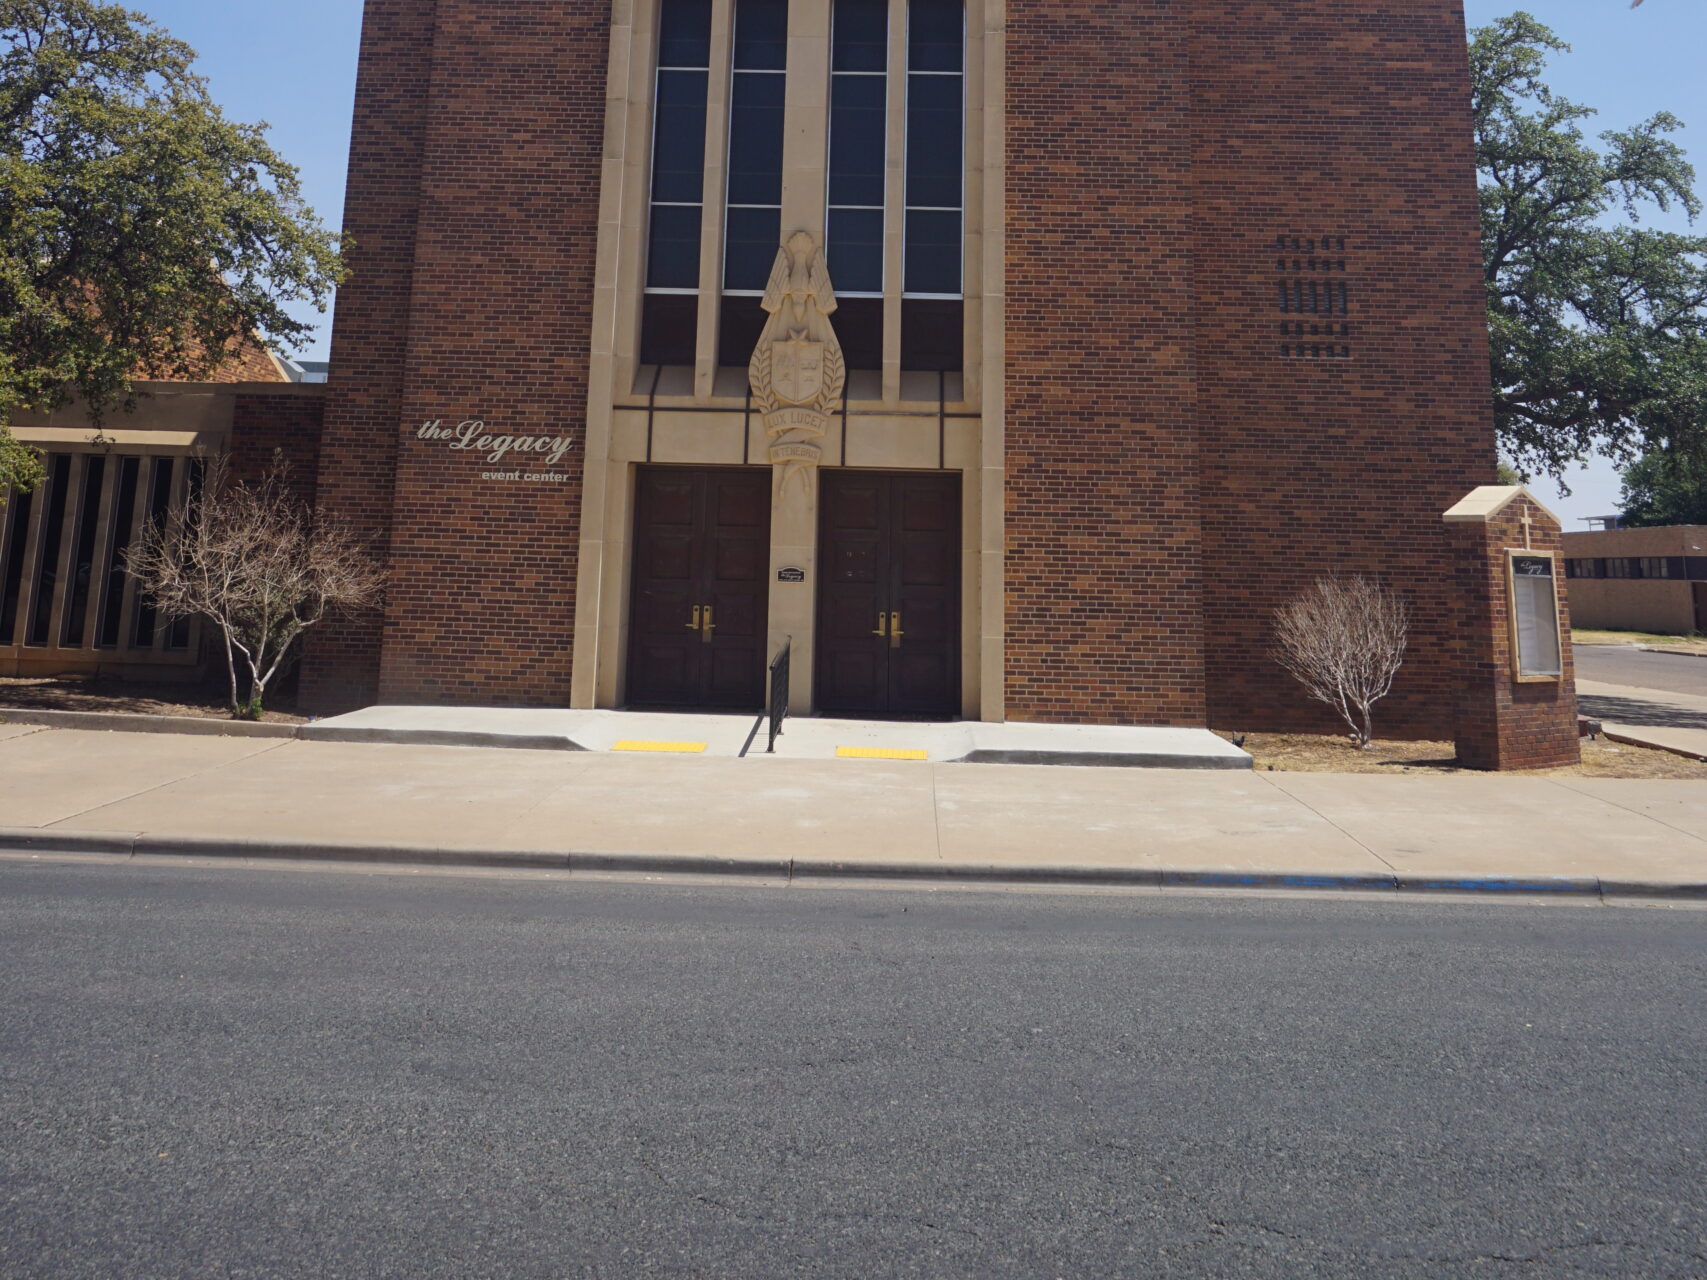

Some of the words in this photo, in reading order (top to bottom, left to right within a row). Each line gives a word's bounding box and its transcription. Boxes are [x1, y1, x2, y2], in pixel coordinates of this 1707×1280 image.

[768, 413, 786, 428] LUX
[791, 412, 824, 431] LUCET
[416, 419, 453, 440] the
[448, 420, 573, 465] Legacy
[481, 471, 520, 481] event
[523, 471, 569, 482] center
